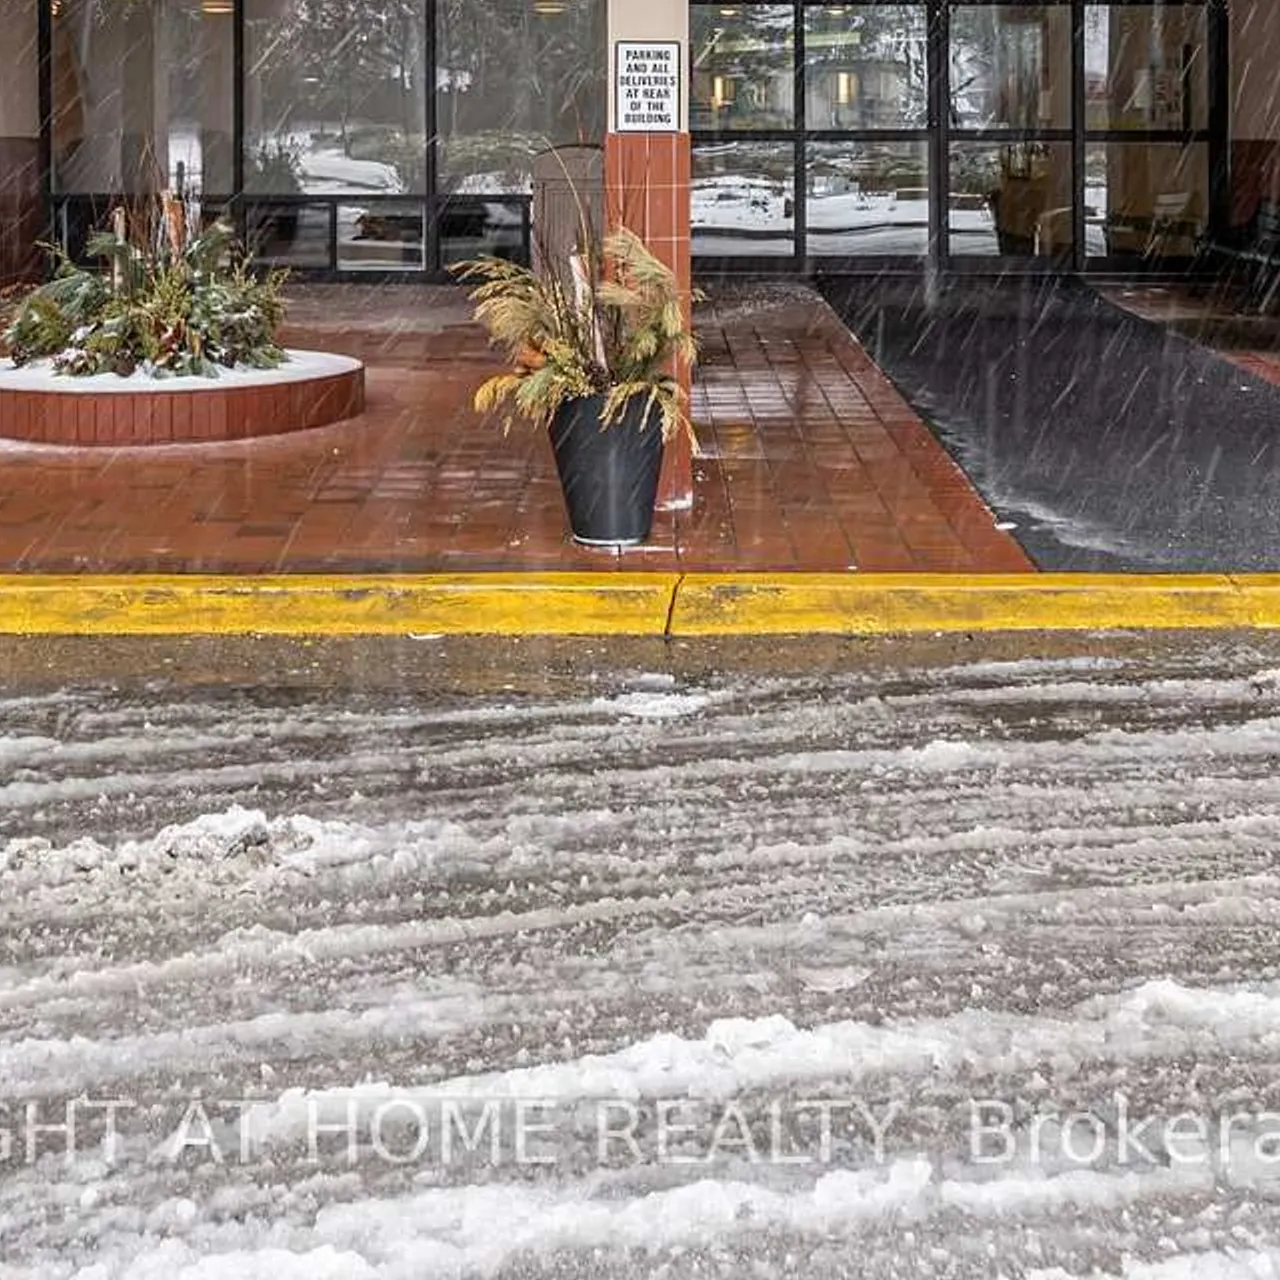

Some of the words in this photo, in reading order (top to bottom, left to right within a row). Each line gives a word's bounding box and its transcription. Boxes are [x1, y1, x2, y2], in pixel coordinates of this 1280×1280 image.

[626, 50, 670, 60] PARKING
[626, 63, 647, 73] AND
[652, 63, 668, 73] ALL
[620, 76, 675, 86] DELIVERIES
[626, 89, 639, 99] AT
[642, 89, 670, 99] REAR
[630, 102, 641, 111] OF
[647, 102, 665, 111] THE
[624, 114, 671, 124] BUILDING
